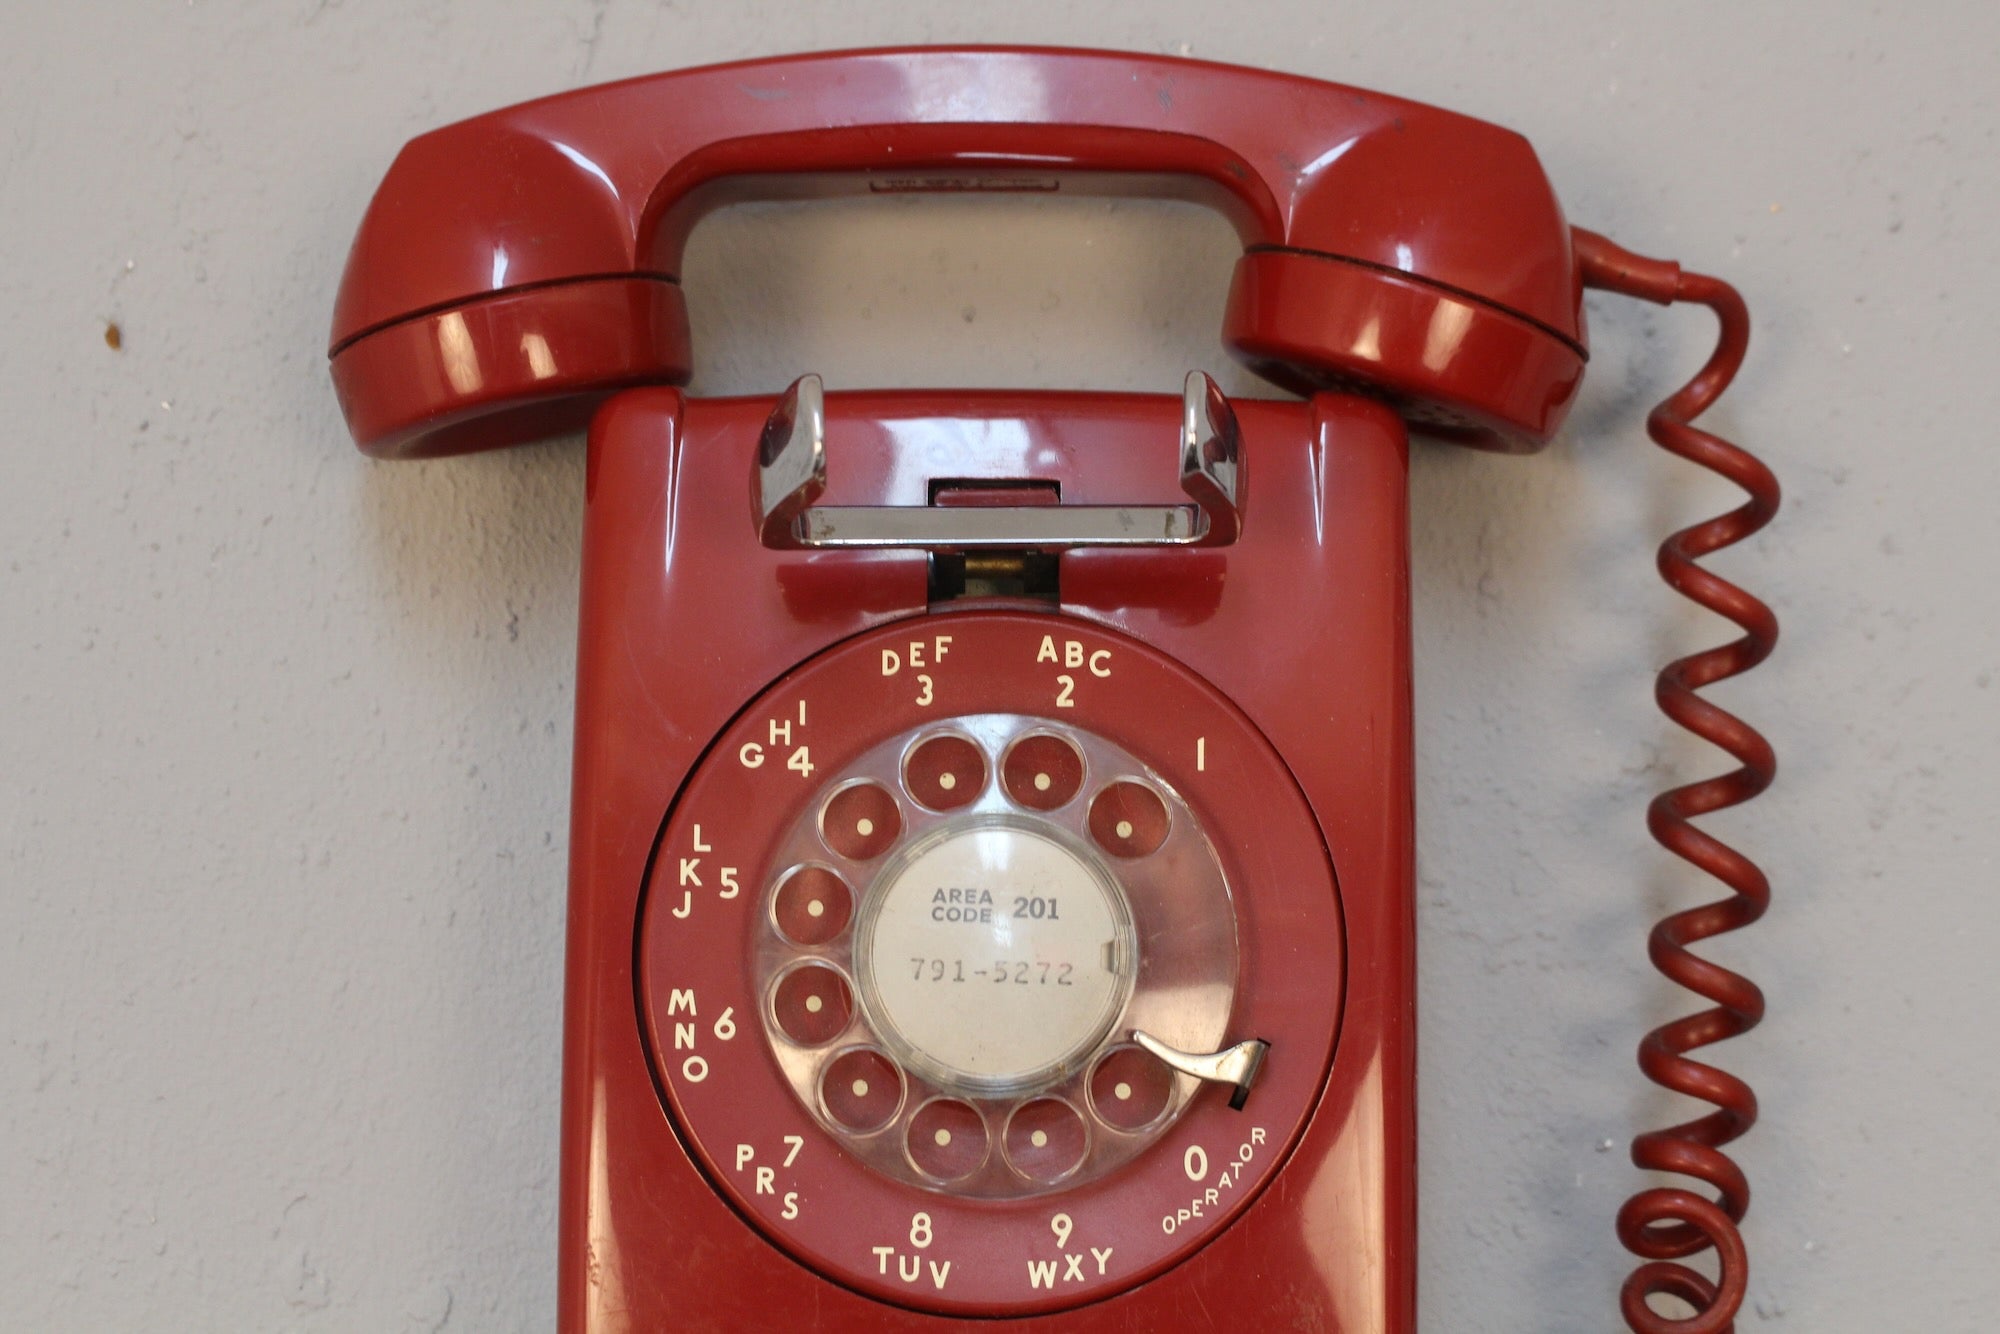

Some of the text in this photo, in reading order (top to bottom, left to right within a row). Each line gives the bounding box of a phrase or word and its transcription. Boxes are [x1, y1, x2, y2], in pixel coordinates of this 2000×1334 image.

[882, 636, 953, 676] DEF
[1036, 635, 1113, 678] ABC
[915, 674, 934, 707] 3
[1056, 675, 1075, 708] 2
[787, 746, 815, 778] 4
[719, 868, 740, 899] 5
[931, 888, 993, 905] AREA
[931, 896, 1060, 923] CODE 201
[910, 958, 1074, 986] 791-5272
[713, 1007, 737, 1041] 6
[783, 1135, 804, 1167] 7
[1162, 1127, 1267, 1234] OPERATOR
[909, 1212, 934, 1249] 8
[1051, 1213, 1074, 1249] 9
[872, 1247, 951, 1289] TUV
[1027, 1248, 1114, 1289] WXY
